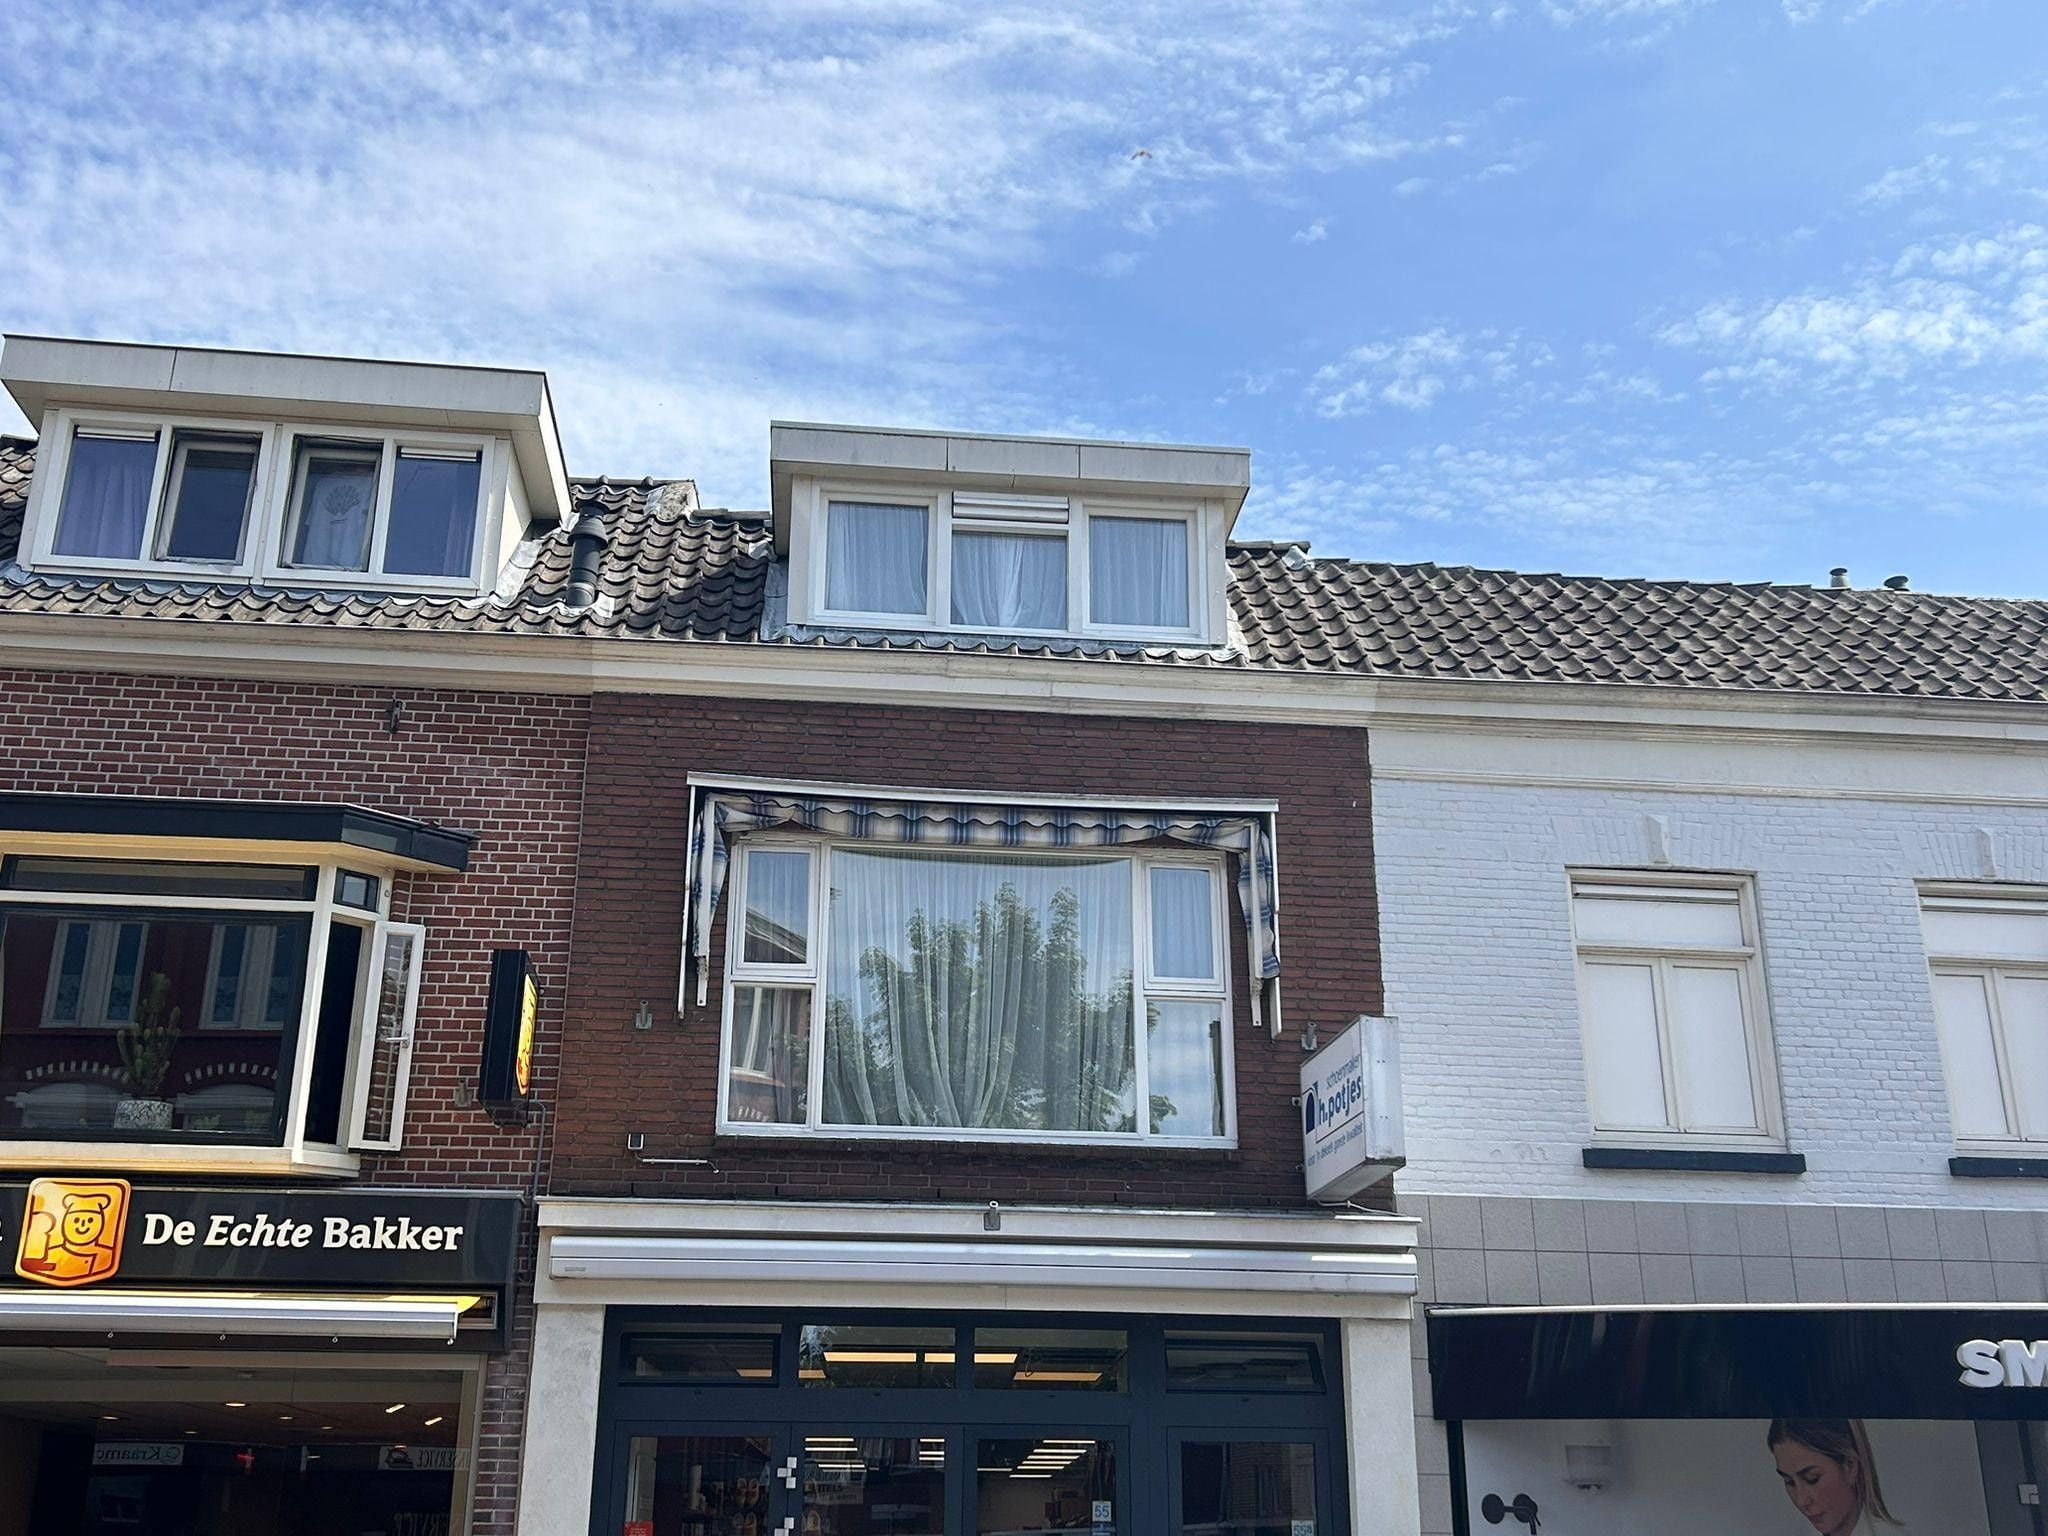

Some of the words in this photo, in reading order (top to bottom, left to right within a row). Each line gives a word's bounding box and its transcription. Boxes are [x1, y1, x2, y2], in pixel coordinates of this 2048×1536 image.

[1319, 1075, 1362, 1127] h.potjes
[143, 1213, 195, 1246] De
[204, 1213, 312, 1248] Echte
[322, 1216, 464, 1251] Bakker
[1094, 1505, 1110, 1518] 55
